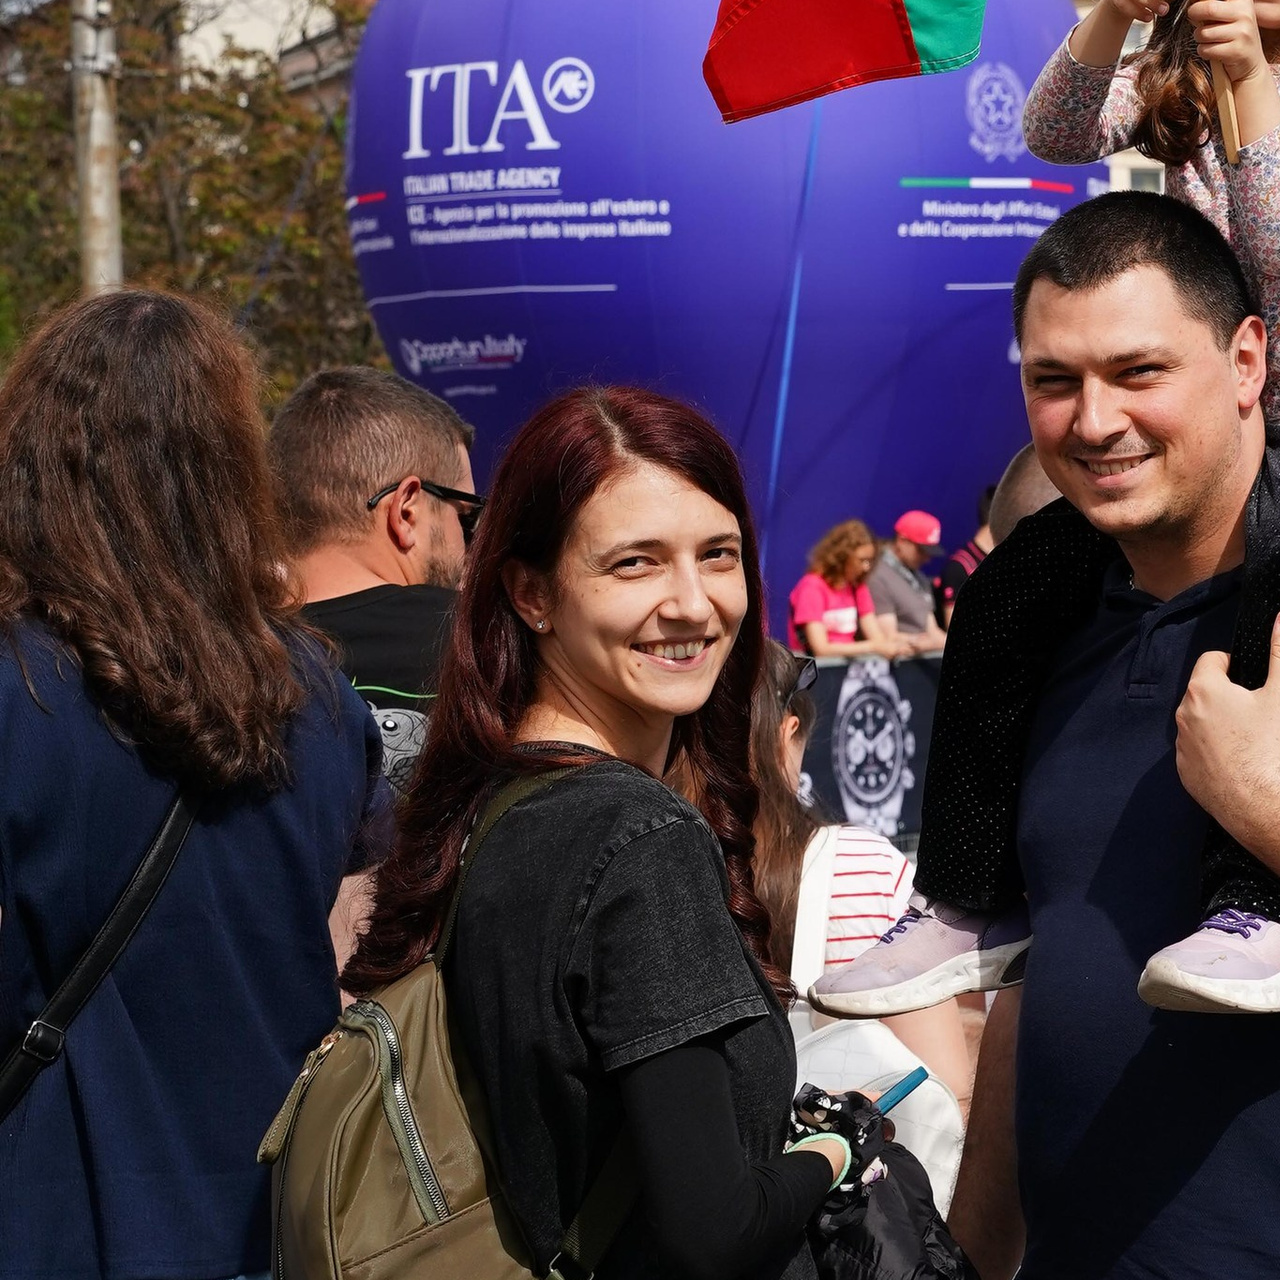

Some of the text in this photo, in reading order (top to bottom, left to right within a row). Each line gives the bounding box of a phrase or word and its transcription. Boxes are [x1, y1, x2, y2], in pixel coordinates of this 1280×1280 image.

[402, 58, 562, 160] ITA
[402, 166, 562, 196] ITALIAN TRADE AGENCY
[510, 199, 589, 222] promozione
[922, 200, 980, 218] Ministero
[981, 200, 1008, 222] degli
[562, 219, 618, 241] imprese
[897, 222, 910, 238] e
[909, 219, 941, 238] della
[941, 219, 1015, 241] Cooperazione
